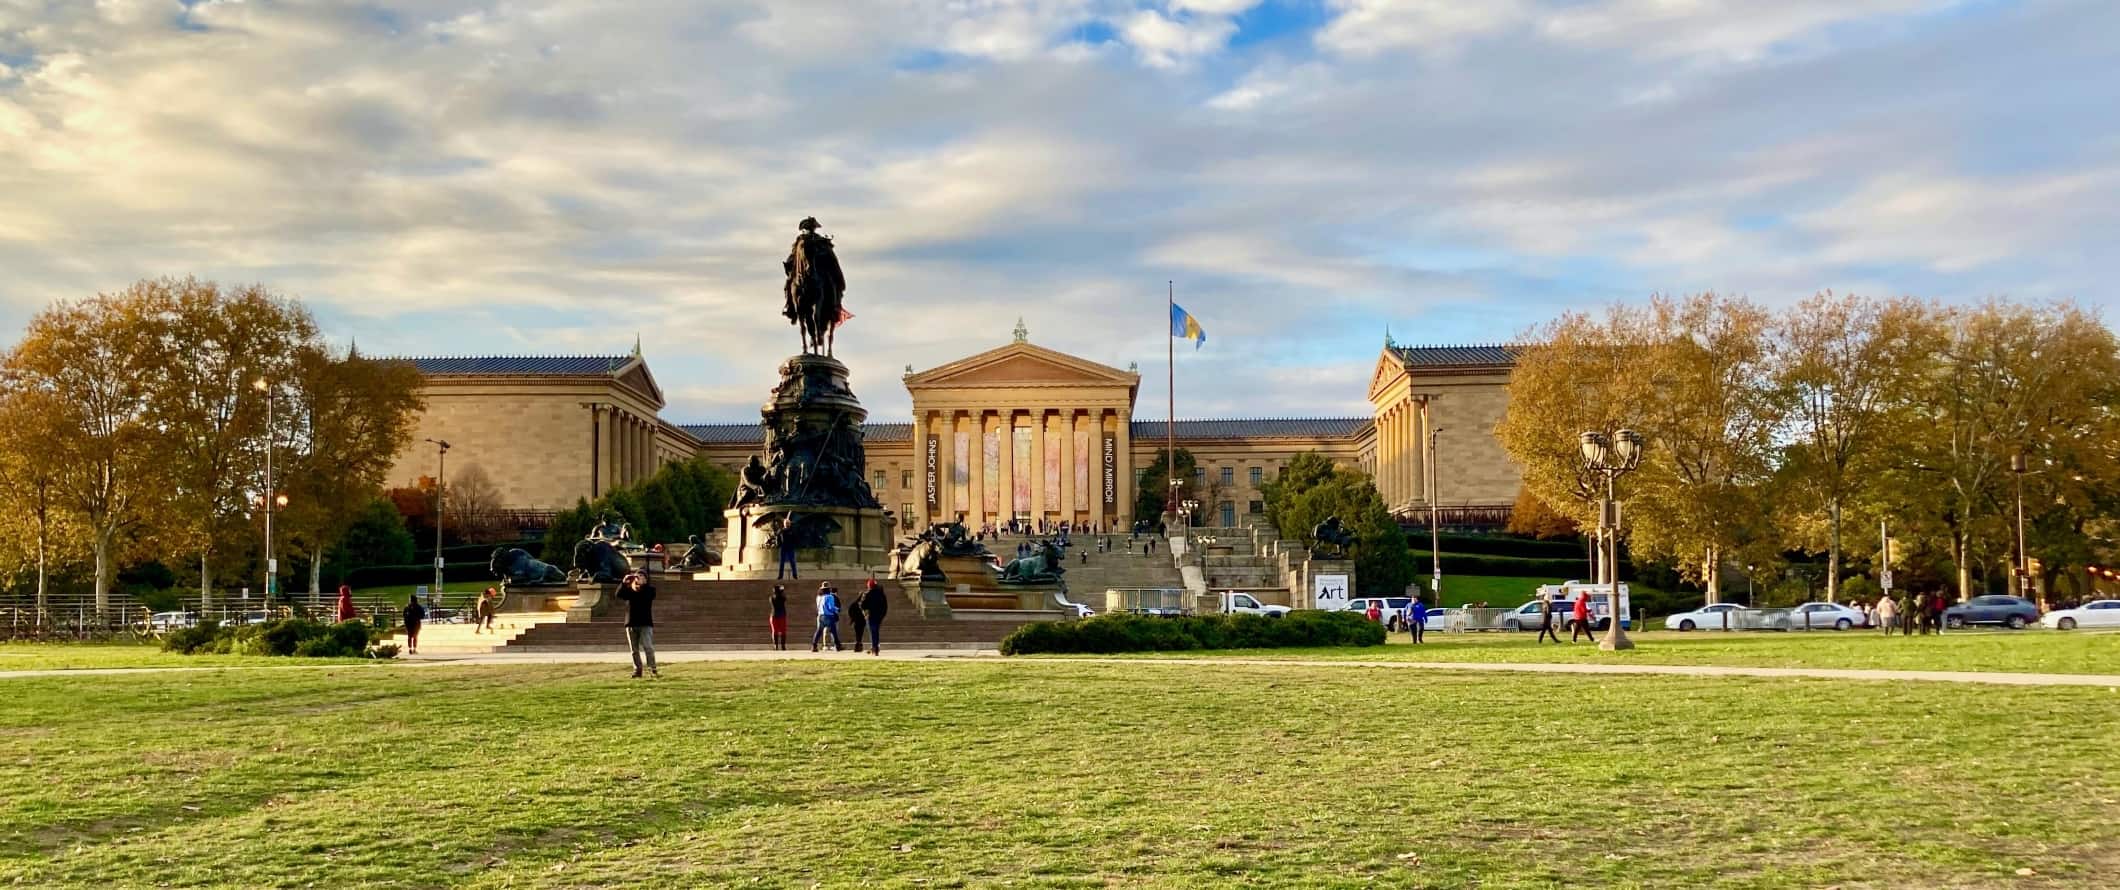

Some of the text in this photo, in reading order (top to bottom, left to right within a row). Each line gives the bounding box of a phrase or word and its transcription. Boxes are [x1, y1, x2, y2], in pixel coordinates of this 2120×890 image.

[928, 439, 936, 504] JASPER JOHNS
[1318, 585, 1344, 599] Art
